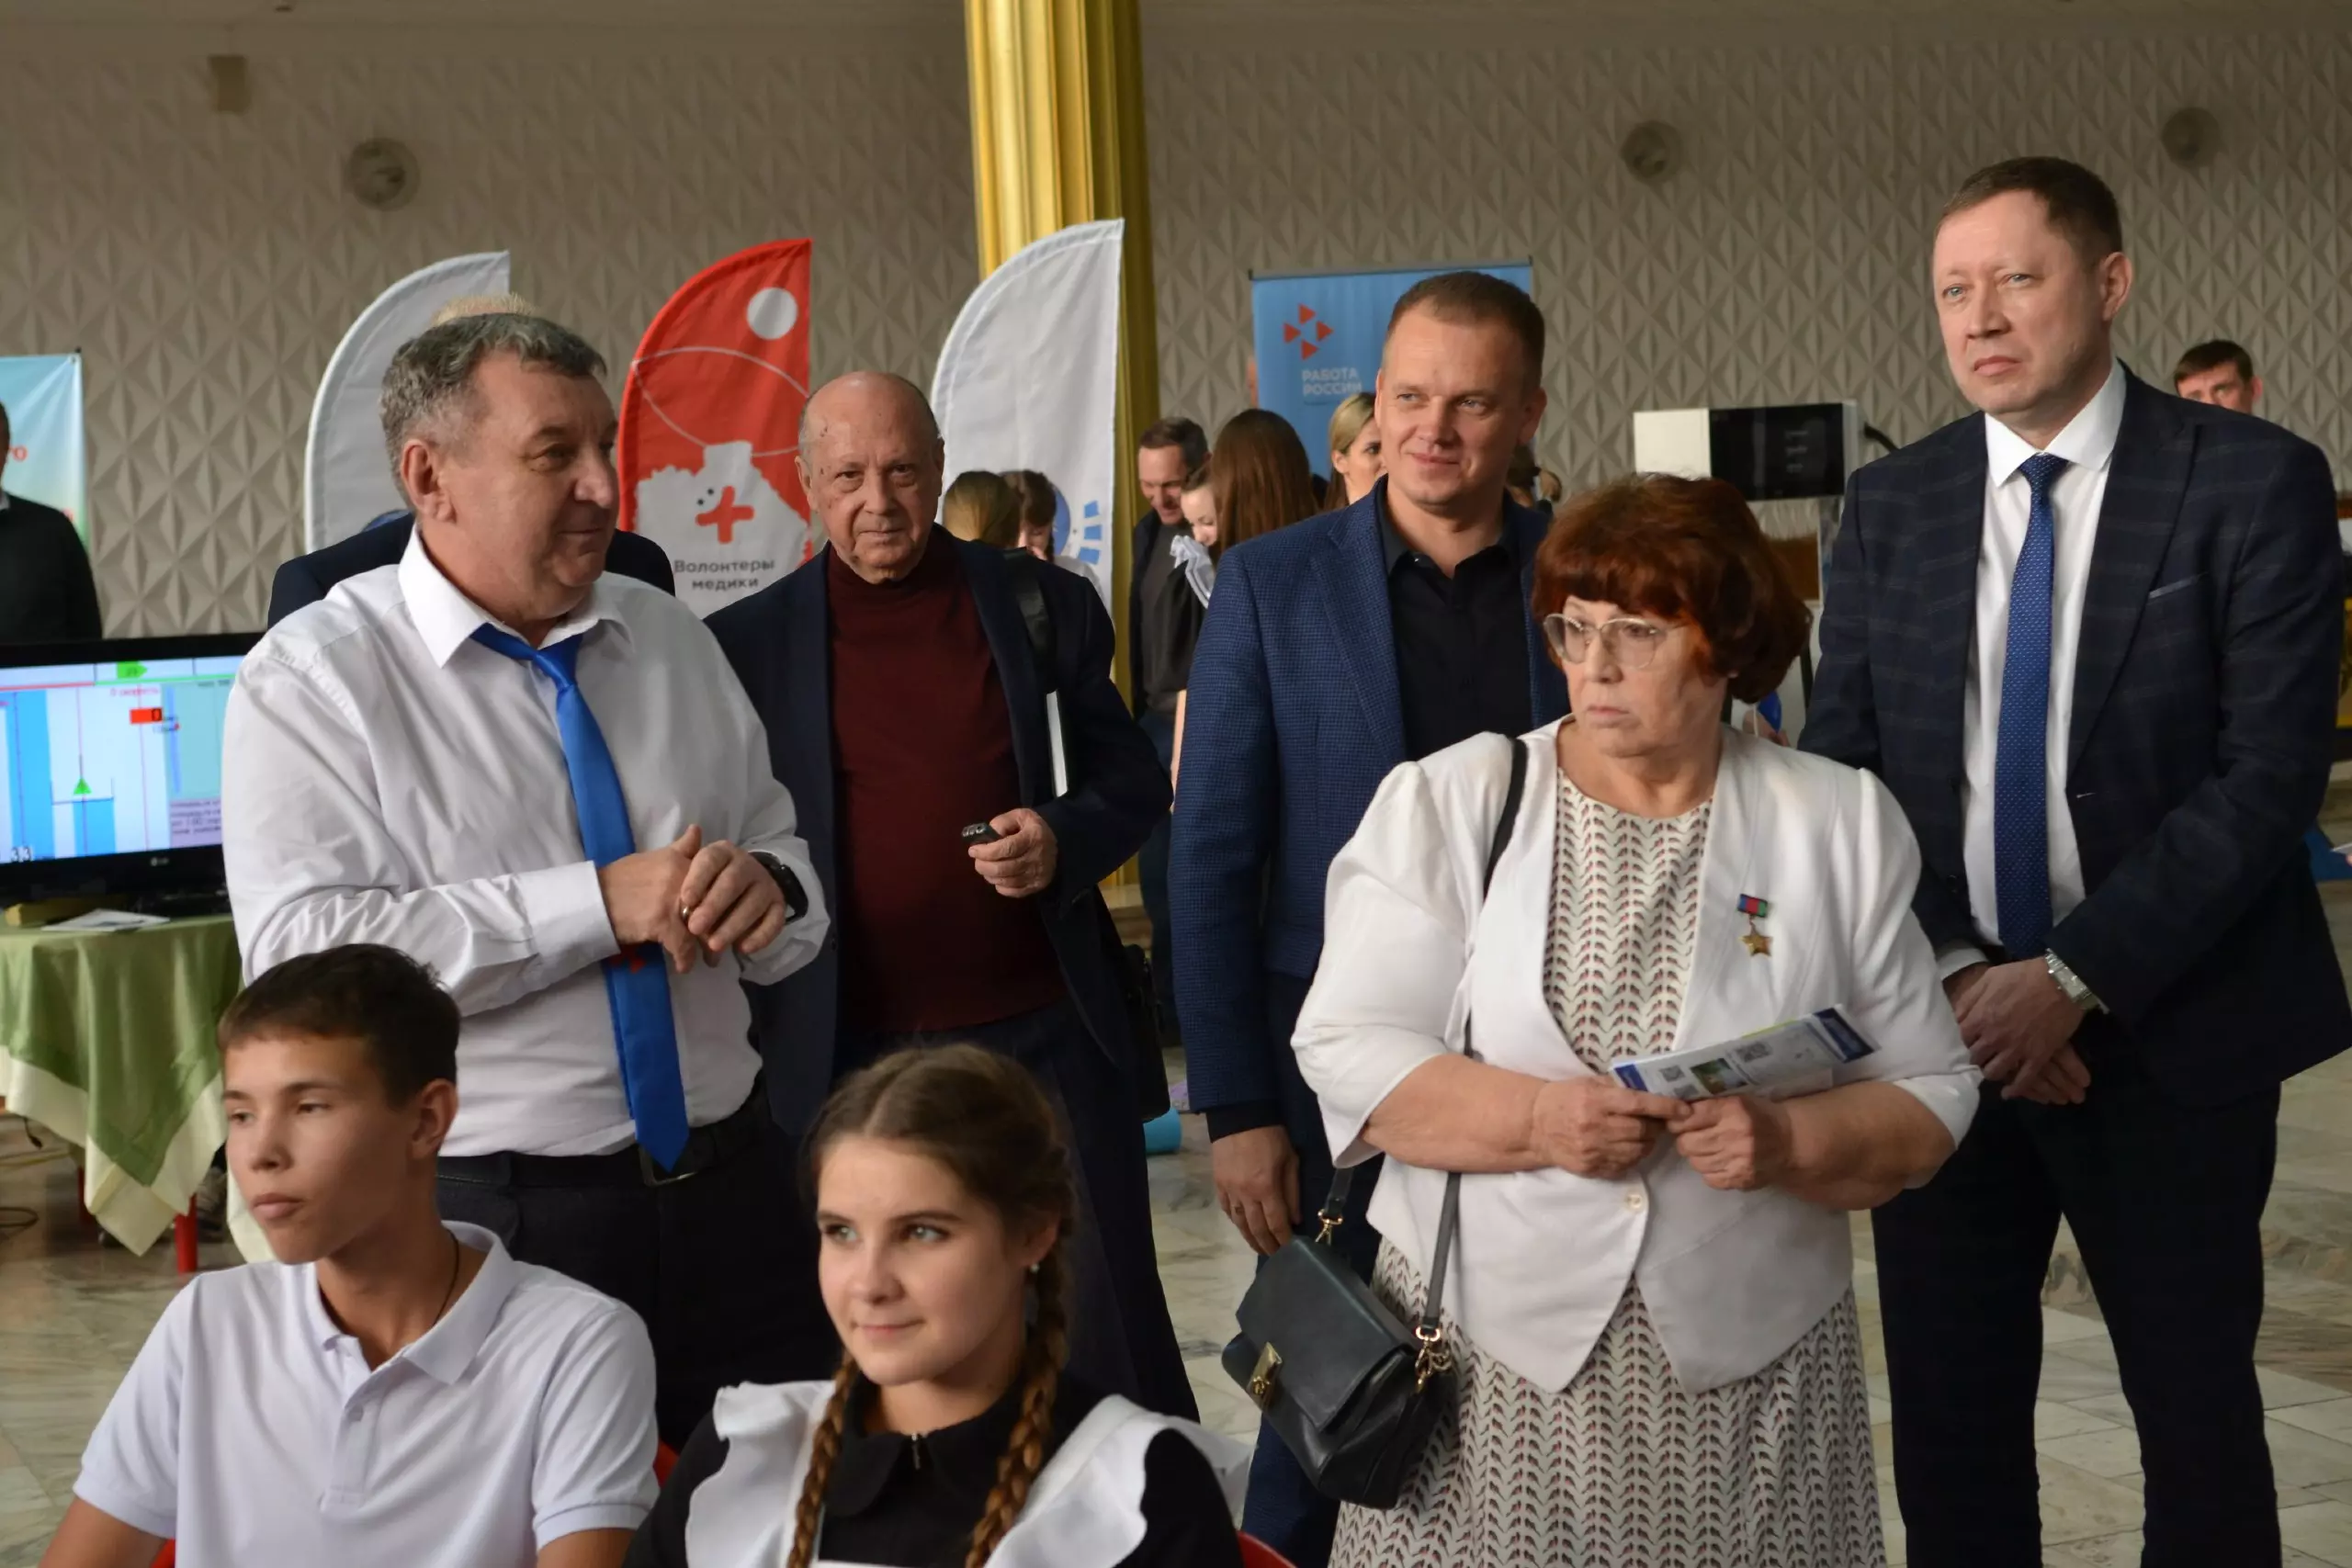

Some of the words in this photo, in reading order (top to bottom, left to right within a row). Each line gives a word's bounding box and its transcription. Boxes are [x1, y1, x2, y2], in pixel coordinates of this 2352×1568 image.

[1302, 367, 1358, 381] РАБОТА
[1303, 382, 1363, 396] РОССИИ
[673, 559, 775, 573] Волонтеры
[692, 578, 759, 591] медики
